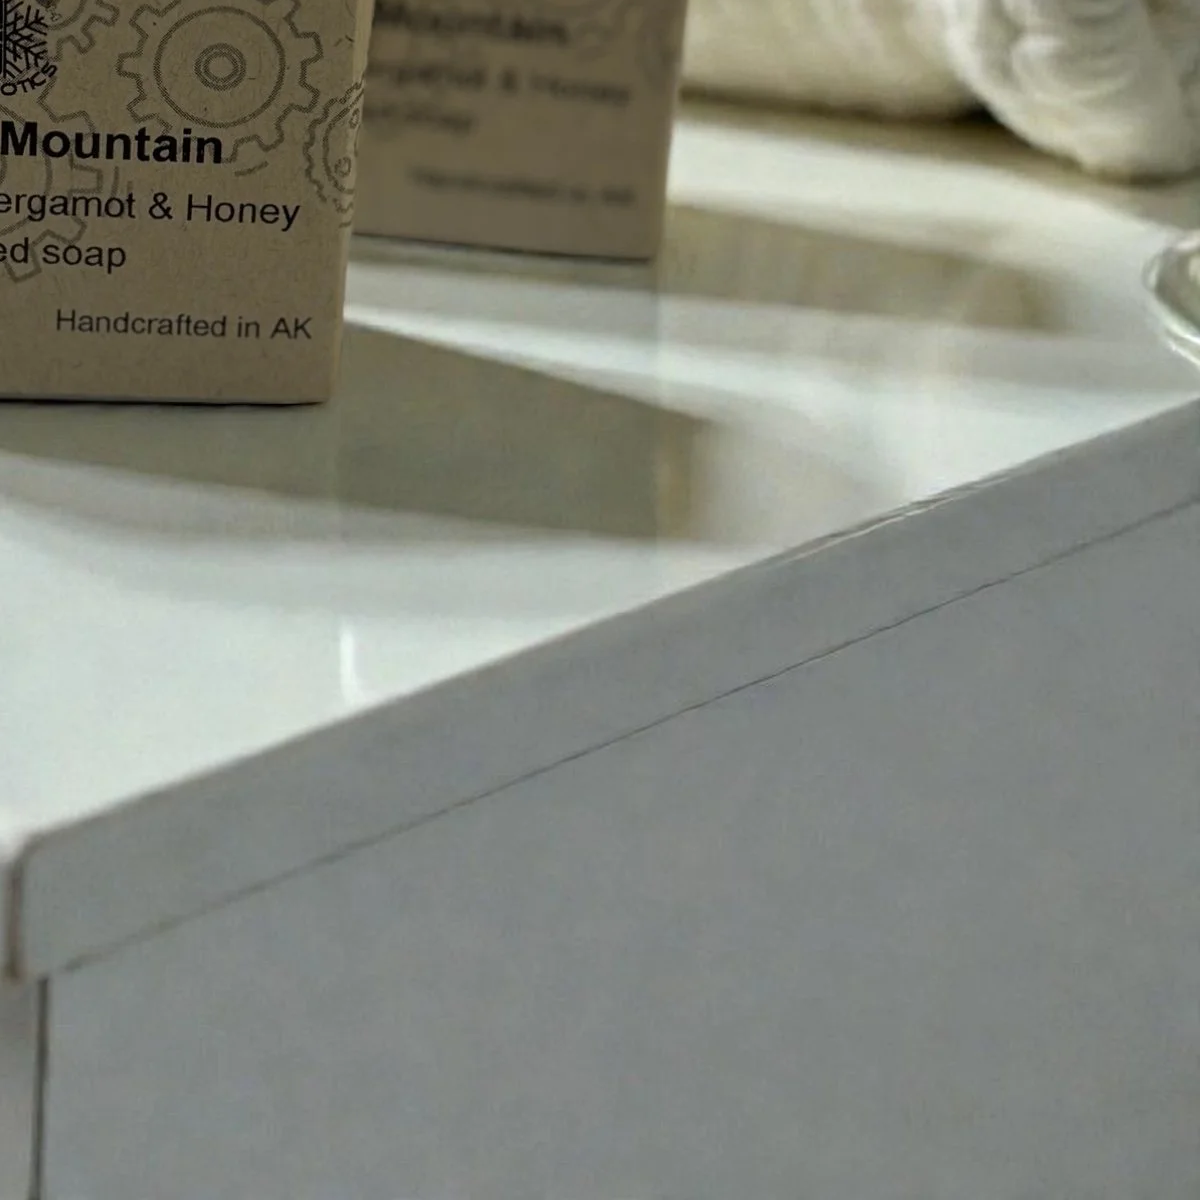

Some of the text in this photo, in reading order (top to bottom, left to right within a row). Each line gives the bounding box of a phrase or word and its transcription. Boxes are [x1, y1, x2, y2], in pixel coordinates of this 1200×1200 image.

[0, 119, 224, 165] Mountain
[148, 191, 174, 220] &
[186, 193, 302, 233] Honey
[42, 243, 128, 275] soap
[56, 308, 313, 340] Handcrafted in AK
